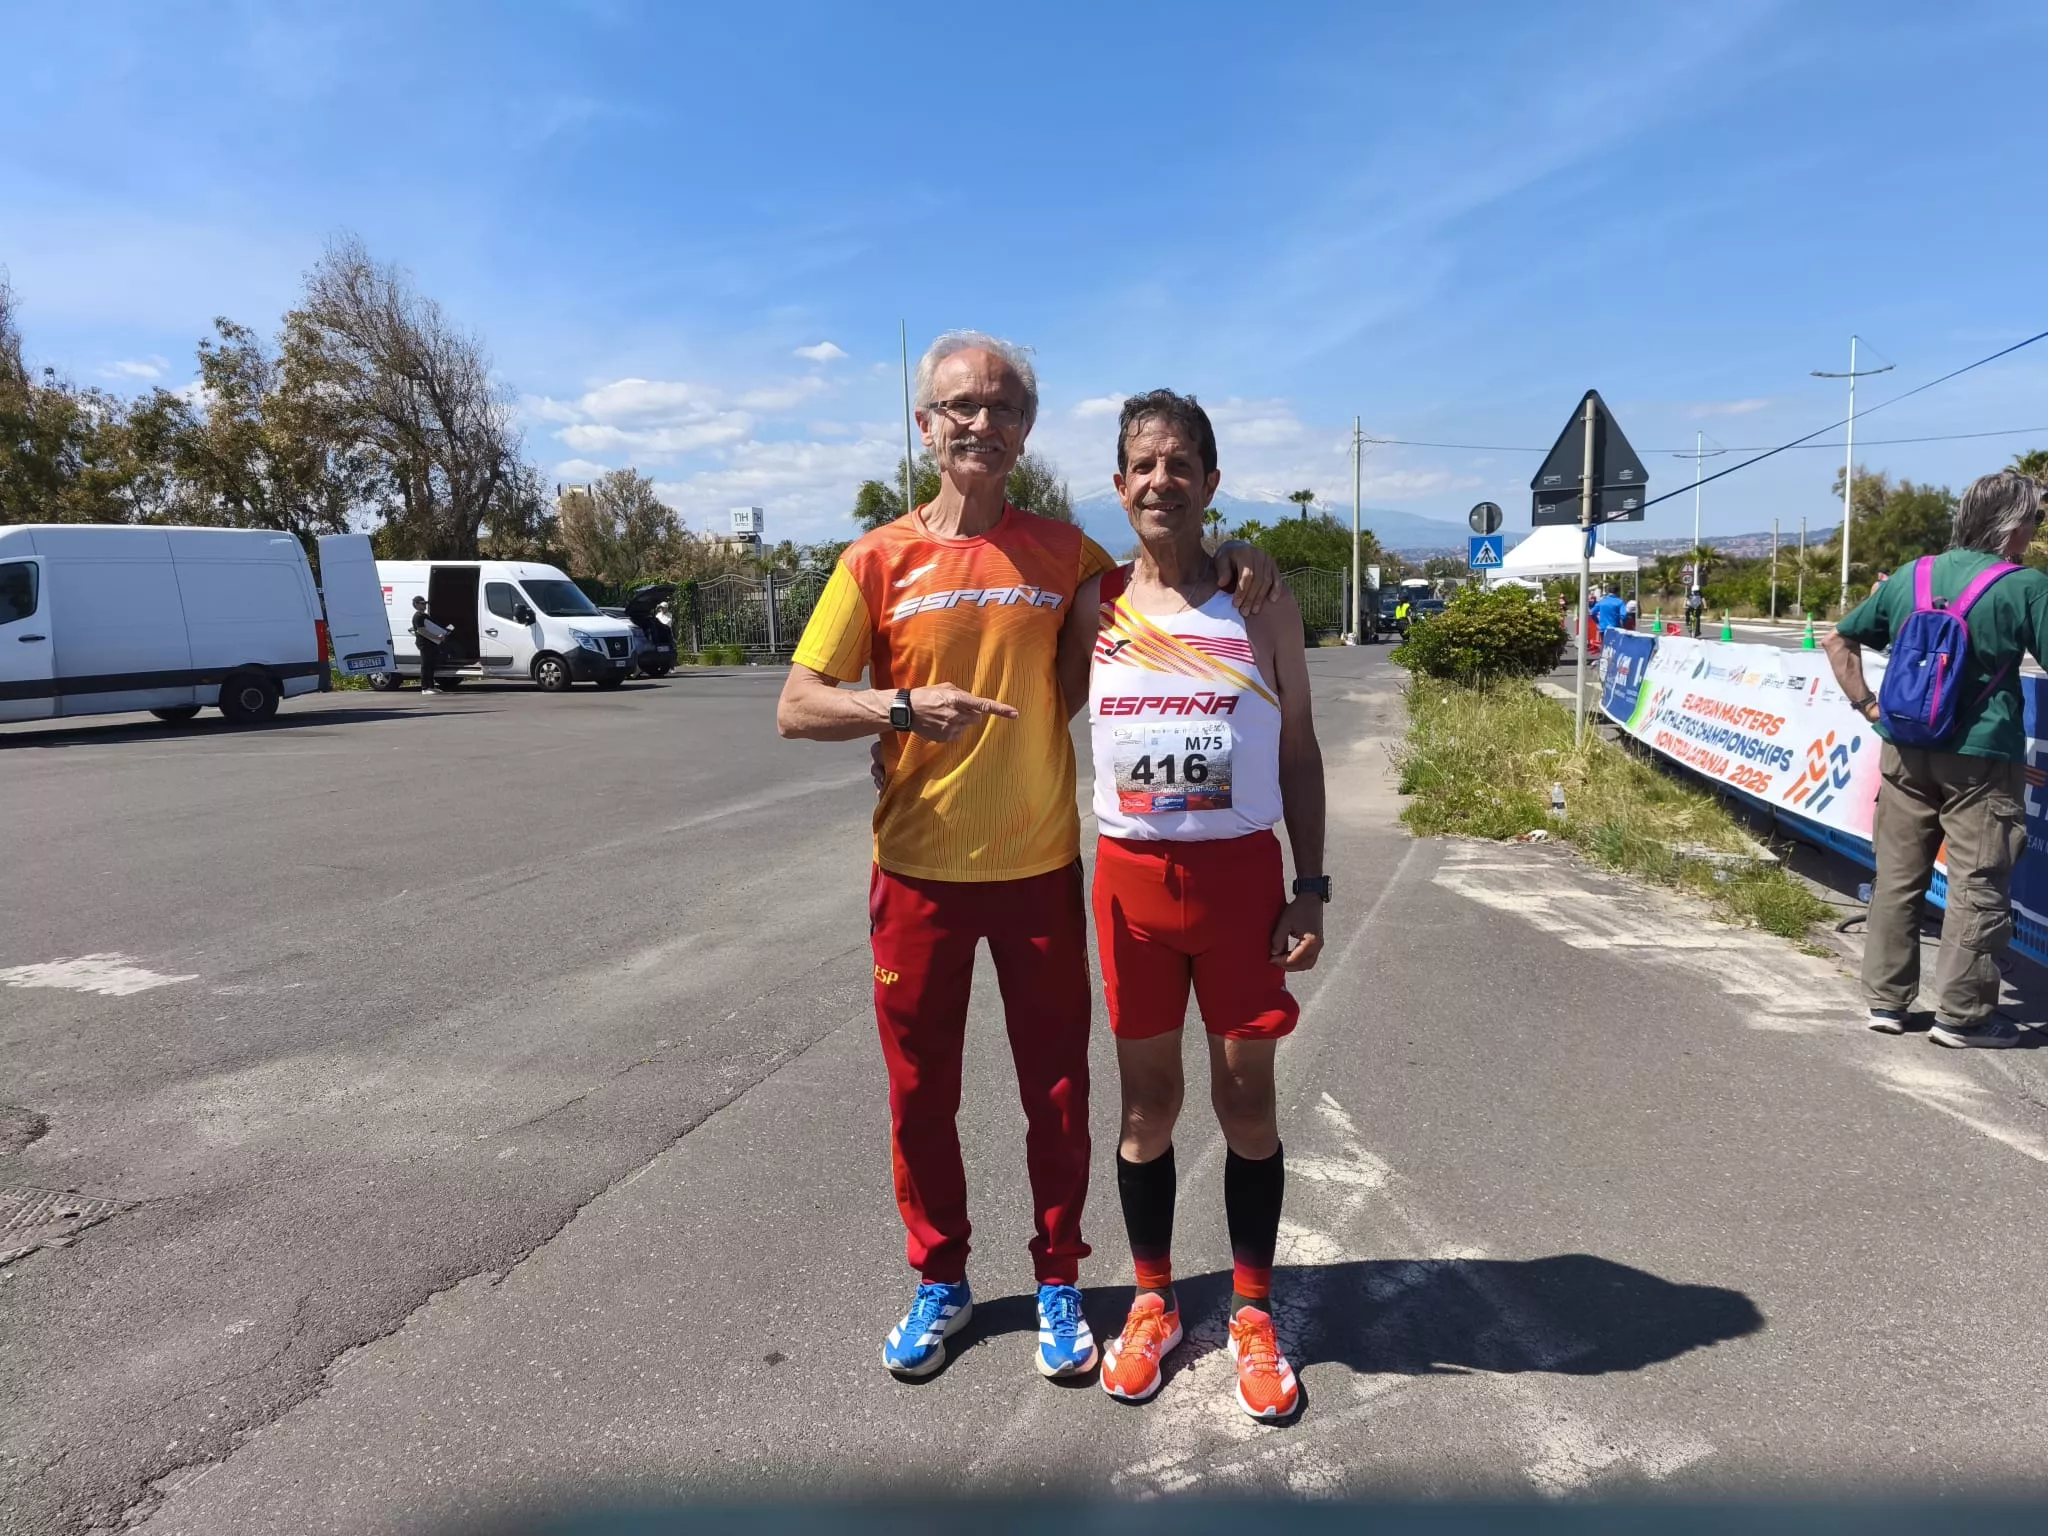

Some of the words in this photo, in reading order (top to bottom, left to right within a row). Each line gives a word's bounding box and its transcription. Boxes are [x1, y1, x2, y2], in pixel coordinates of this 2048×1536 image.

[890, 584, 1064, 623] ESPAÑA
[1099, 691, 1240, 716] ESPAÑA
[1719, 703, 1786, 736] MASTERS
[1185, 736, 1223, 751] M75
[1695, 720, 1794, 772] CHAMPIONSHIPS
[1131, 753, 1209, 786] 416
[1727, 764, 1773, 794] 2026
[874, 964, 899, 985] ESP
